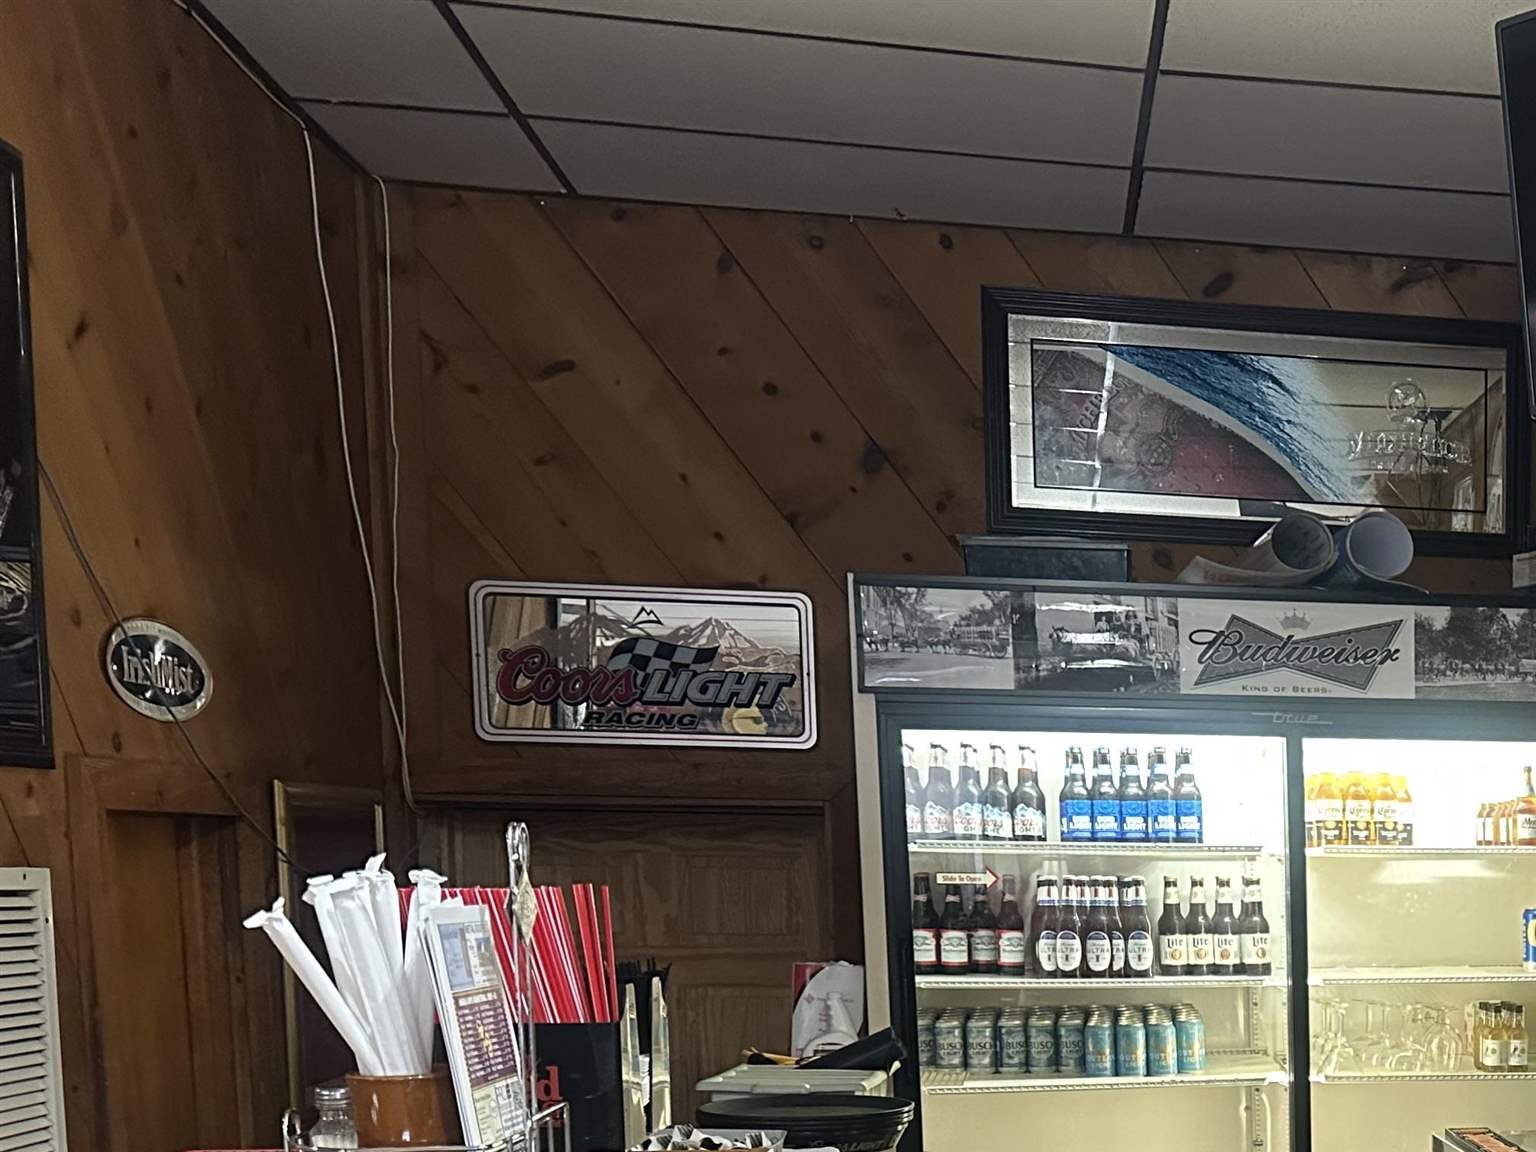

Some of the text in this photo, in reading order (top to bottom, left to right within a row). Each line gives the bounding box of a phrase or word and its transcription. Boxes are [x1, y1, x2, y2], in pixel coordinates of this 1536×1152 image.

[1188, 628, 1401, 666] Budweiser
[496, 644, 798, 708] Coors LIGHT
[1241, 684, 1269, 693] KING
[583, 709, 701, 730] RACING
[1166, 938, 1184, 949] Lite
[1192, 938, 1209, 948] Lite
[1217, 938, 1234, 948] Lite
[1252, 937, 1271, 947] Lite
